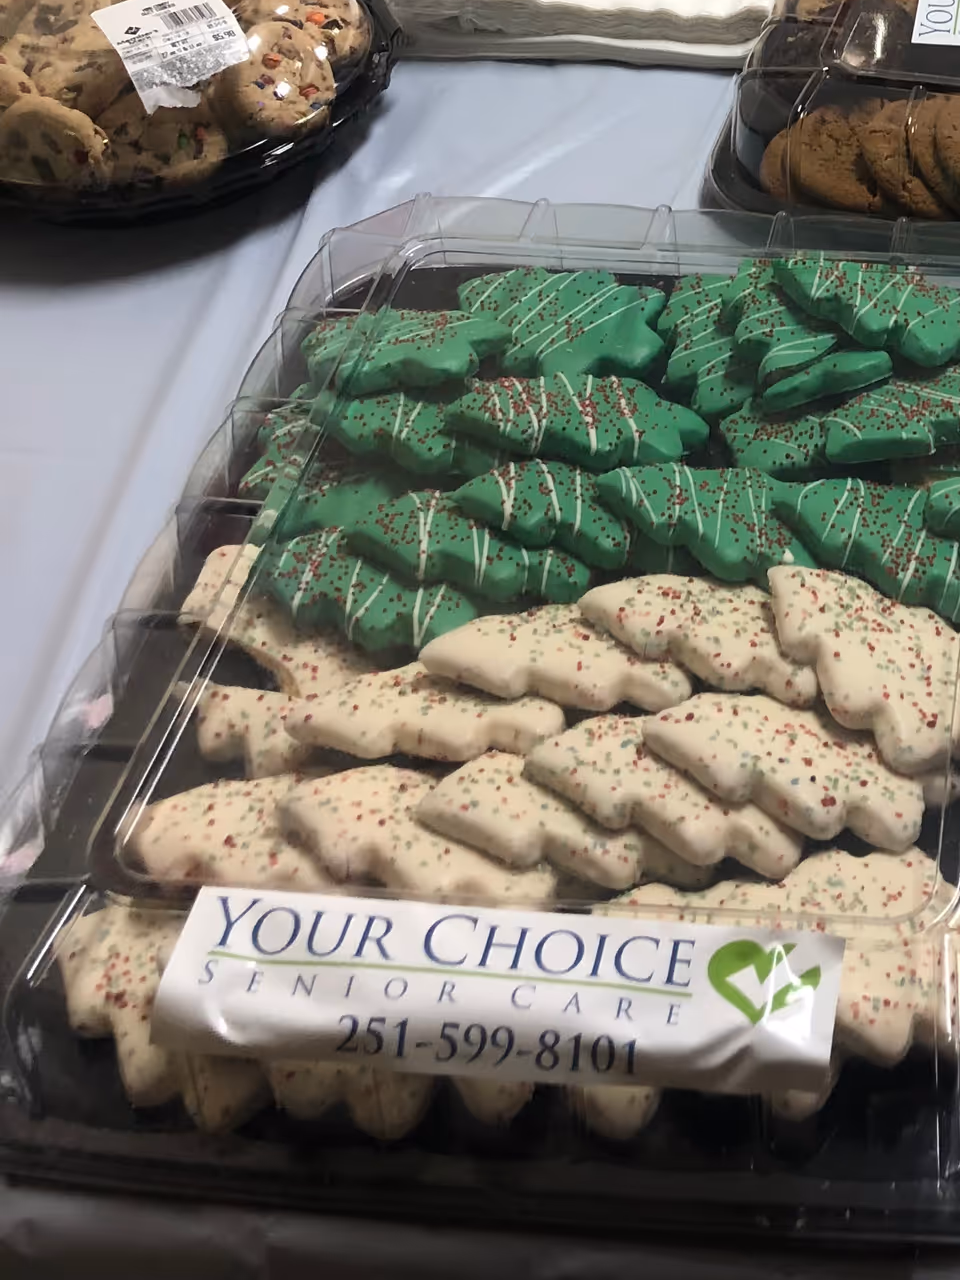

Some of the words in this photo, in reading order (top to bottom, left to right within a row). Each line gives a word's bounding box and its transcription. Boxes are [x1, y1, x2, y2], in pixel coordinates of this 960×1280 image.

[211, 894, 395, 962] YOUR
[422, 912, 696, 989] CHOICE
[198, 959, 459, 1007] SENIOR
[510, 983, 682, 1027] CARE
[335, 1014, 640, 1076] 251-599-8101
